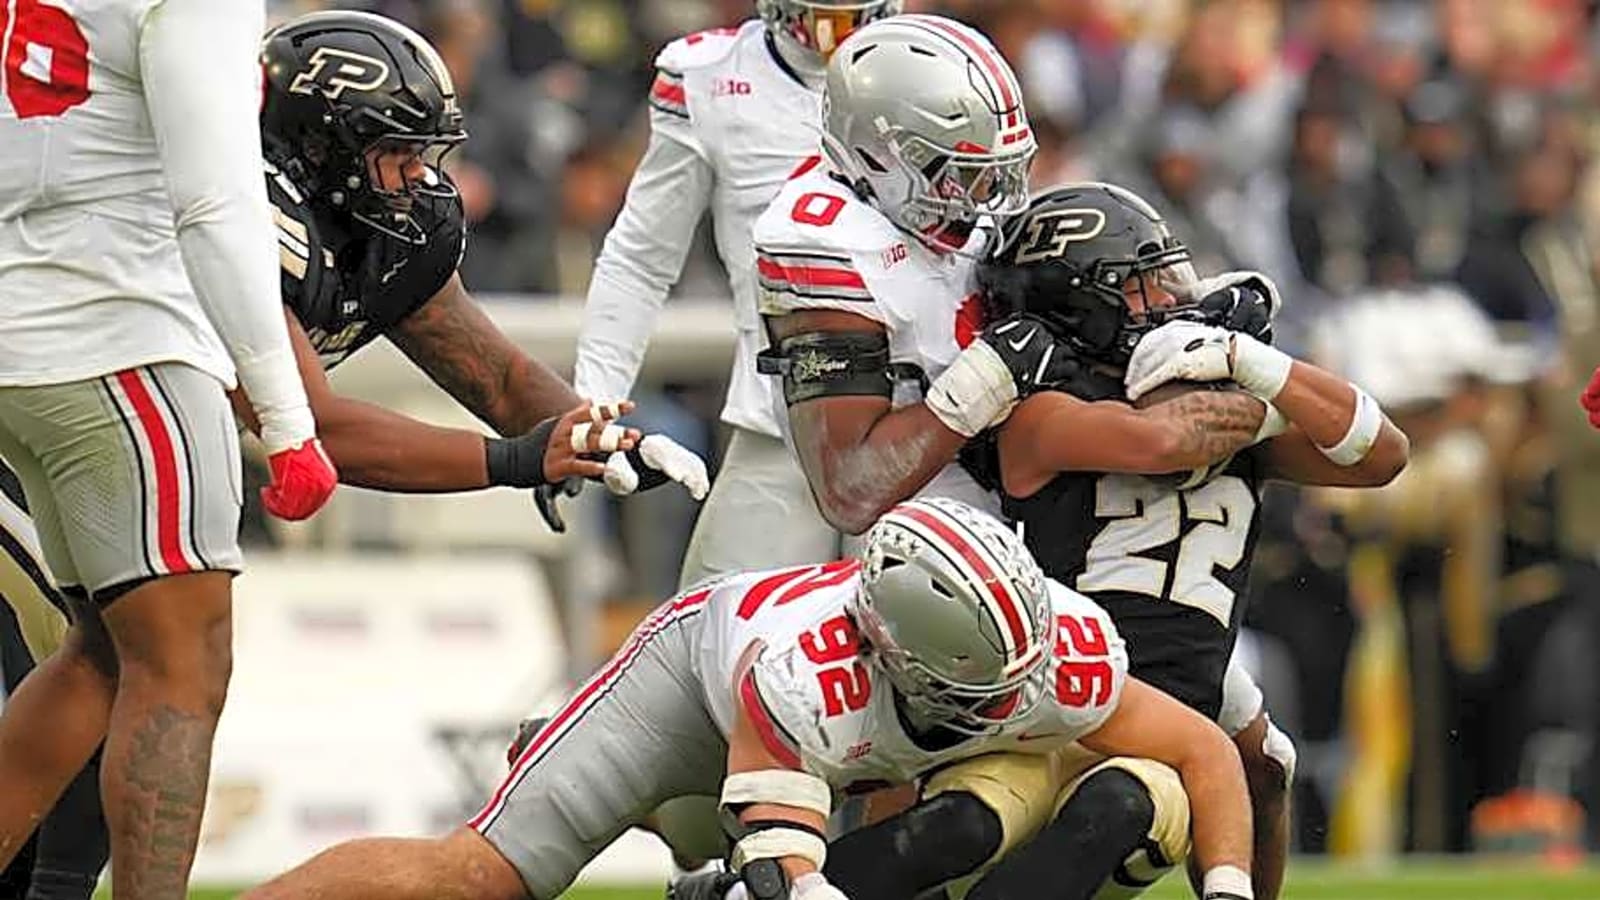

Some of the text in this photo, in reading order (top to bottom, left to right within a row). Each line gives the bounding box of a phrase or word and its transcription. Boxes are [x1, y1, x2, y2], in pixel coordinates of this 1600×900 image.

[289, 47, 389, 99] P
[792, 192, 847, 227] 0
[1015, 208, 1106, 264] P
[1076, 474, 1257, 629] 22
[798, 615, 872, 718] 92
[1054, 614, 1113, 708] 92
